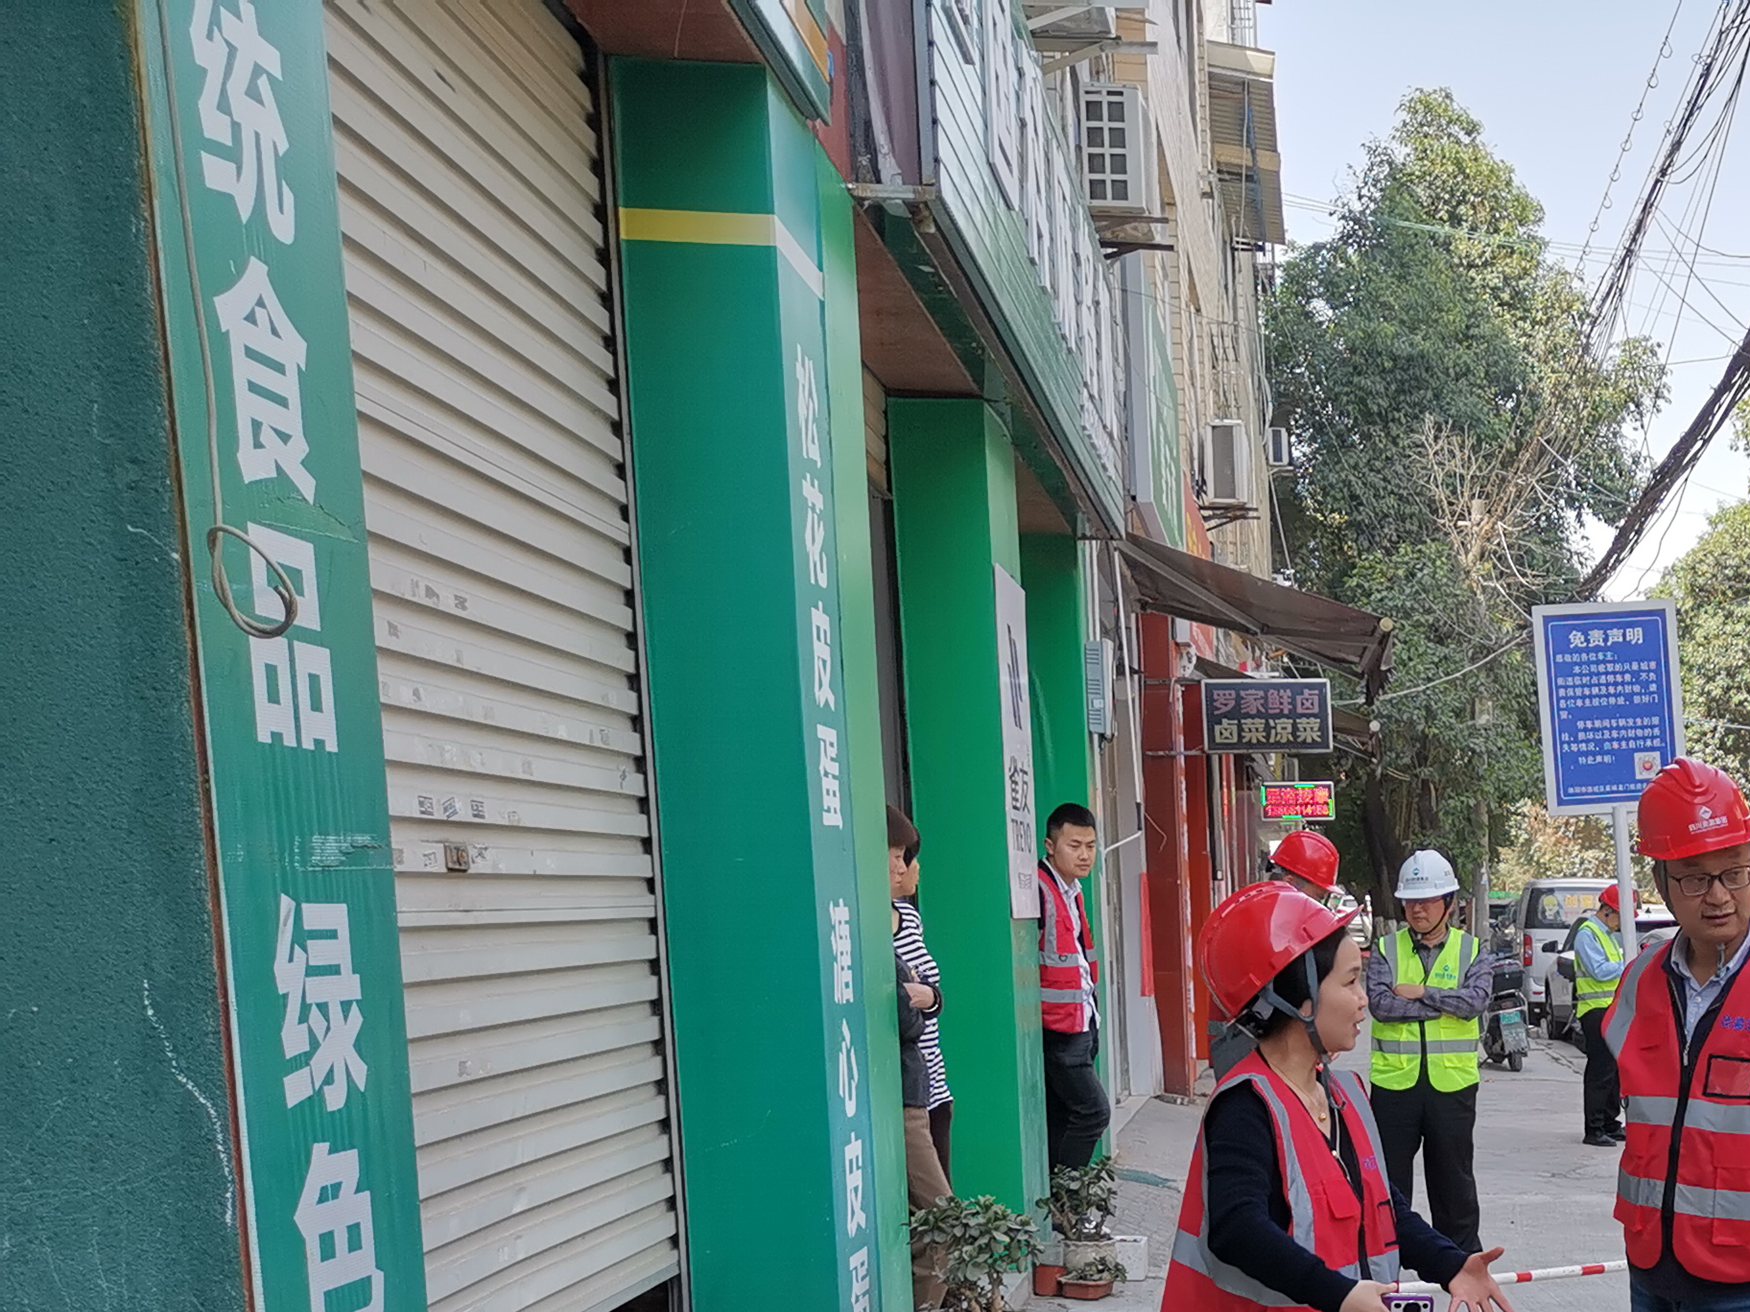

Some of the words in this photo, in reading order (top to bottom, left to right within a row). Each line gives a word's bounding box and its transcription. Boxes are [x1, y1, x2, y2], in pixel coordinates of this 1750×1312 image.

[795, 342, 844, 831] 松花皮蛋
[1568, 627, 1644, 648] 免责声明
[1212, 689, 1320, 715] 罗家鲜卤
[1214, 718, 1322, 744] 卤菜凉菜
